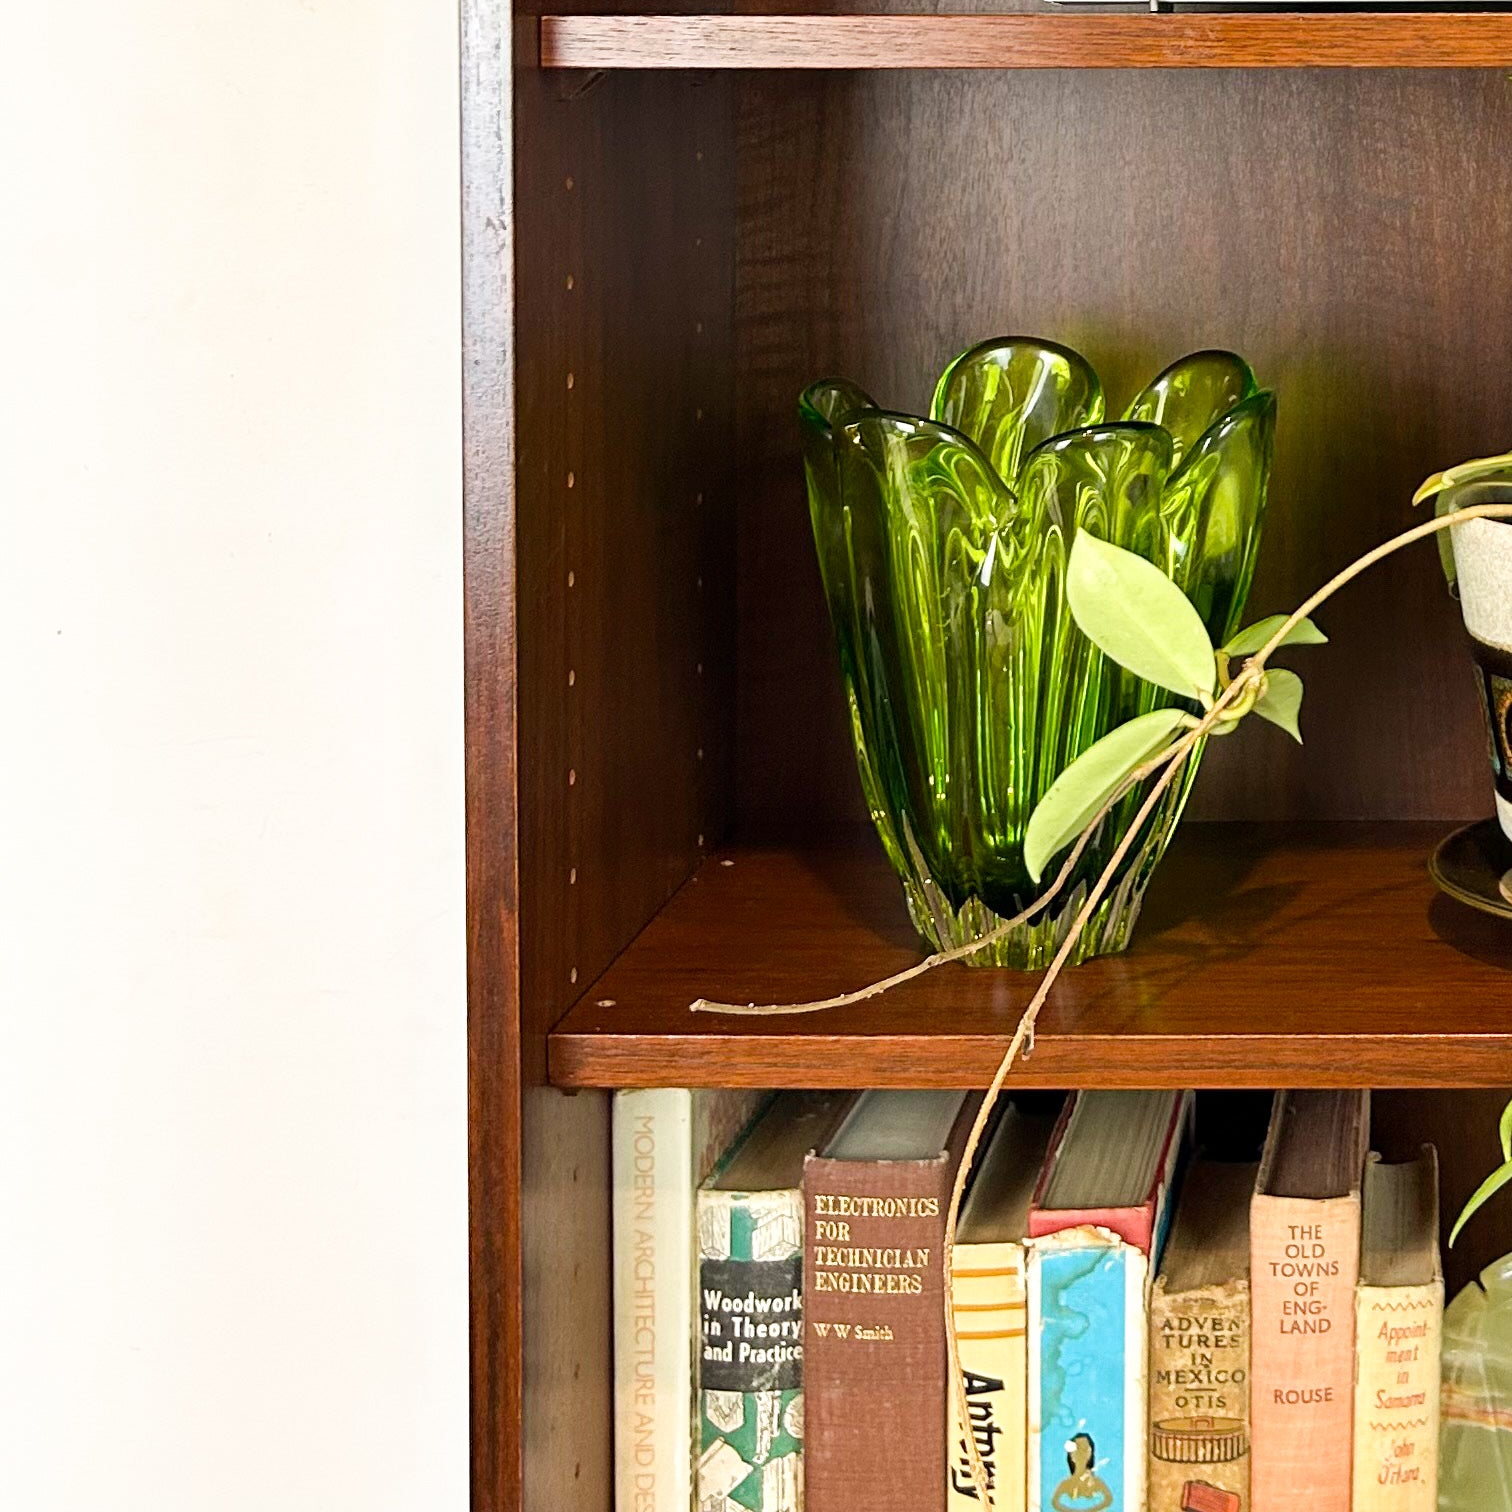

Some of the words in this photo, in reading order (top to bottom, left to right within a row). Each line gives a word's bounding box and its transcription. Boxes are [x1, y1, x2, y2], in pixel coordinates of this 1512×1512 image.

[633, 1115, 655, 1220] MODERN
[814, 1194, 940, 1217] ELECTRONICS
[815, 1220, 850, 1241] FOR
[1288, 1225, 1322, 1240] THE
[813, 1246, 931, 1268] TECHNICIAN
[1285, 1243, 1326, 1259] OLD
[1268, 1261, 1340, 1278] TOWNS
[814, 1271, 923, 1294] ENGINEERS
[1293, 1281, 1319, 1297] OF
[703, 1288, 803, 1313] Woodwork
[1283, 1300, 1328, 1316] ENG-
[634, 1229, 656, 1405] ARCHITECTURE
[703, 1314, 721, 1336] in
[731, 1316, 802, 1340] Theory
[855, 1325, 894, 1341] Smith
[1280, 1318, 1332, 1335] LAND
[1161, 1334, 1242, 1348] TURES
[703, 1341, 733, 1362] and
[739, 1341, 804, 1363] Practice
[1191, 1352, 1213, 1366] IN
[1385, 1345, 1419, 1364] ment
[1155, 1369, 1246, 1385] MEXICO
[1396, 1371, 1410, 1385] in
[1175, 1395, 1227, 1409] OTIS
[1273, 1387, 1334, 1405] ROUSE
[633, 1412, 656, 1466] AND
